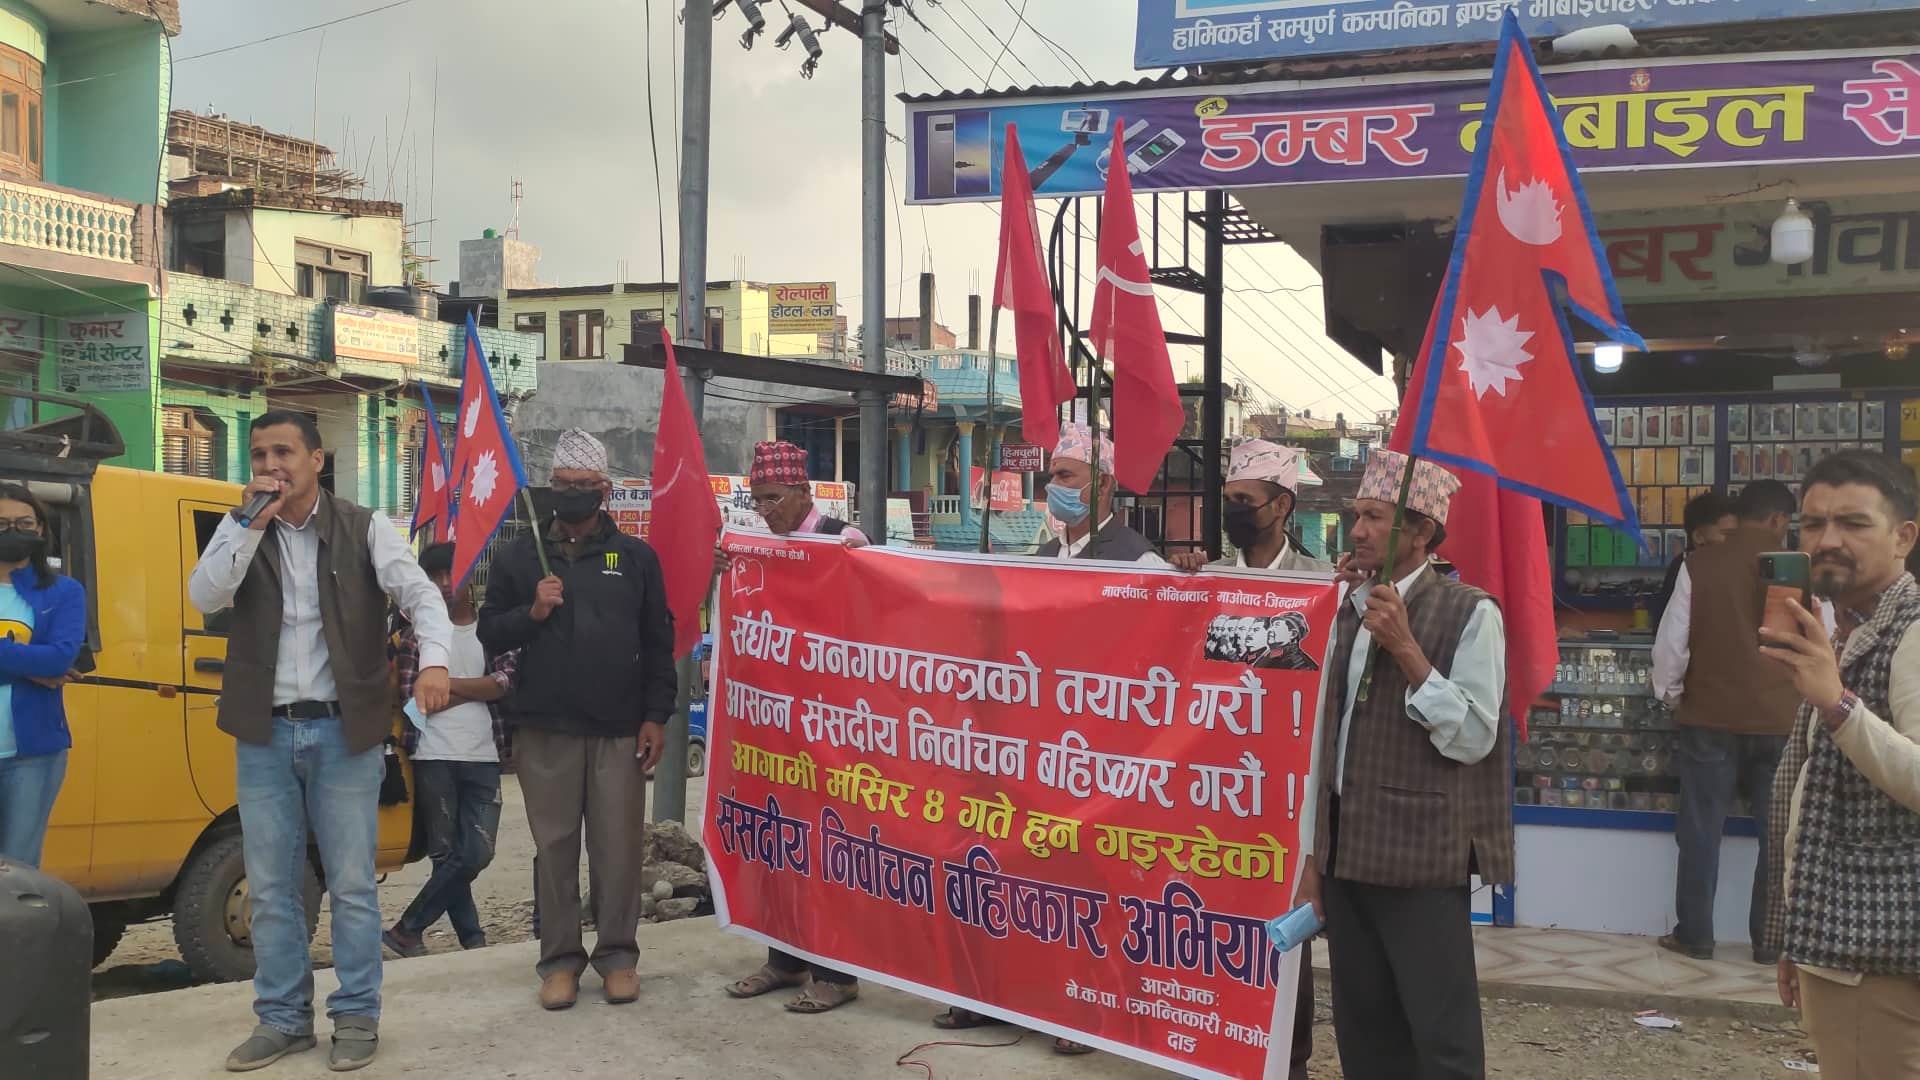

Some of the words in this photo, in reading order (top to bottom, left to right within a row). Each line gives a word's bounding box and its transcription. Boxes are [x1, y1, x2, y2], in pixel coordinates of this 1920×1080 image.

[1200, 103, 1436, 172] डम्बर
[1458, 84, 1816, 158] बाइल
[67, 319, 125, 346] कुमार
[730, 610, 796, 665] संघीय
[800, 632, 1042, 707] जनगणतन्त्रको
[1055, 666, 1181, 727] तयारी
[725, 679, 795, 733] आसन्न
[800, 693, 899, 757] संसदीय
[908, 707, 1029, 782] निर्वाचन
[1037, 730, 1177, 809] बहिष्कार
[715, 786, 812, 878] संसदीय
[819, 806, 936, 915] निर्वाचन
[942, 844, 1109, 959] बहिष्कार
[731, 740, 817, 792] आगामी
[825, 762, 915, 818] मंसिर
[958, 791, 1017, 840] गते
[1022, 811, 1082, 858] हुन
[1095, 825, 1289, 884] गइरहेको
